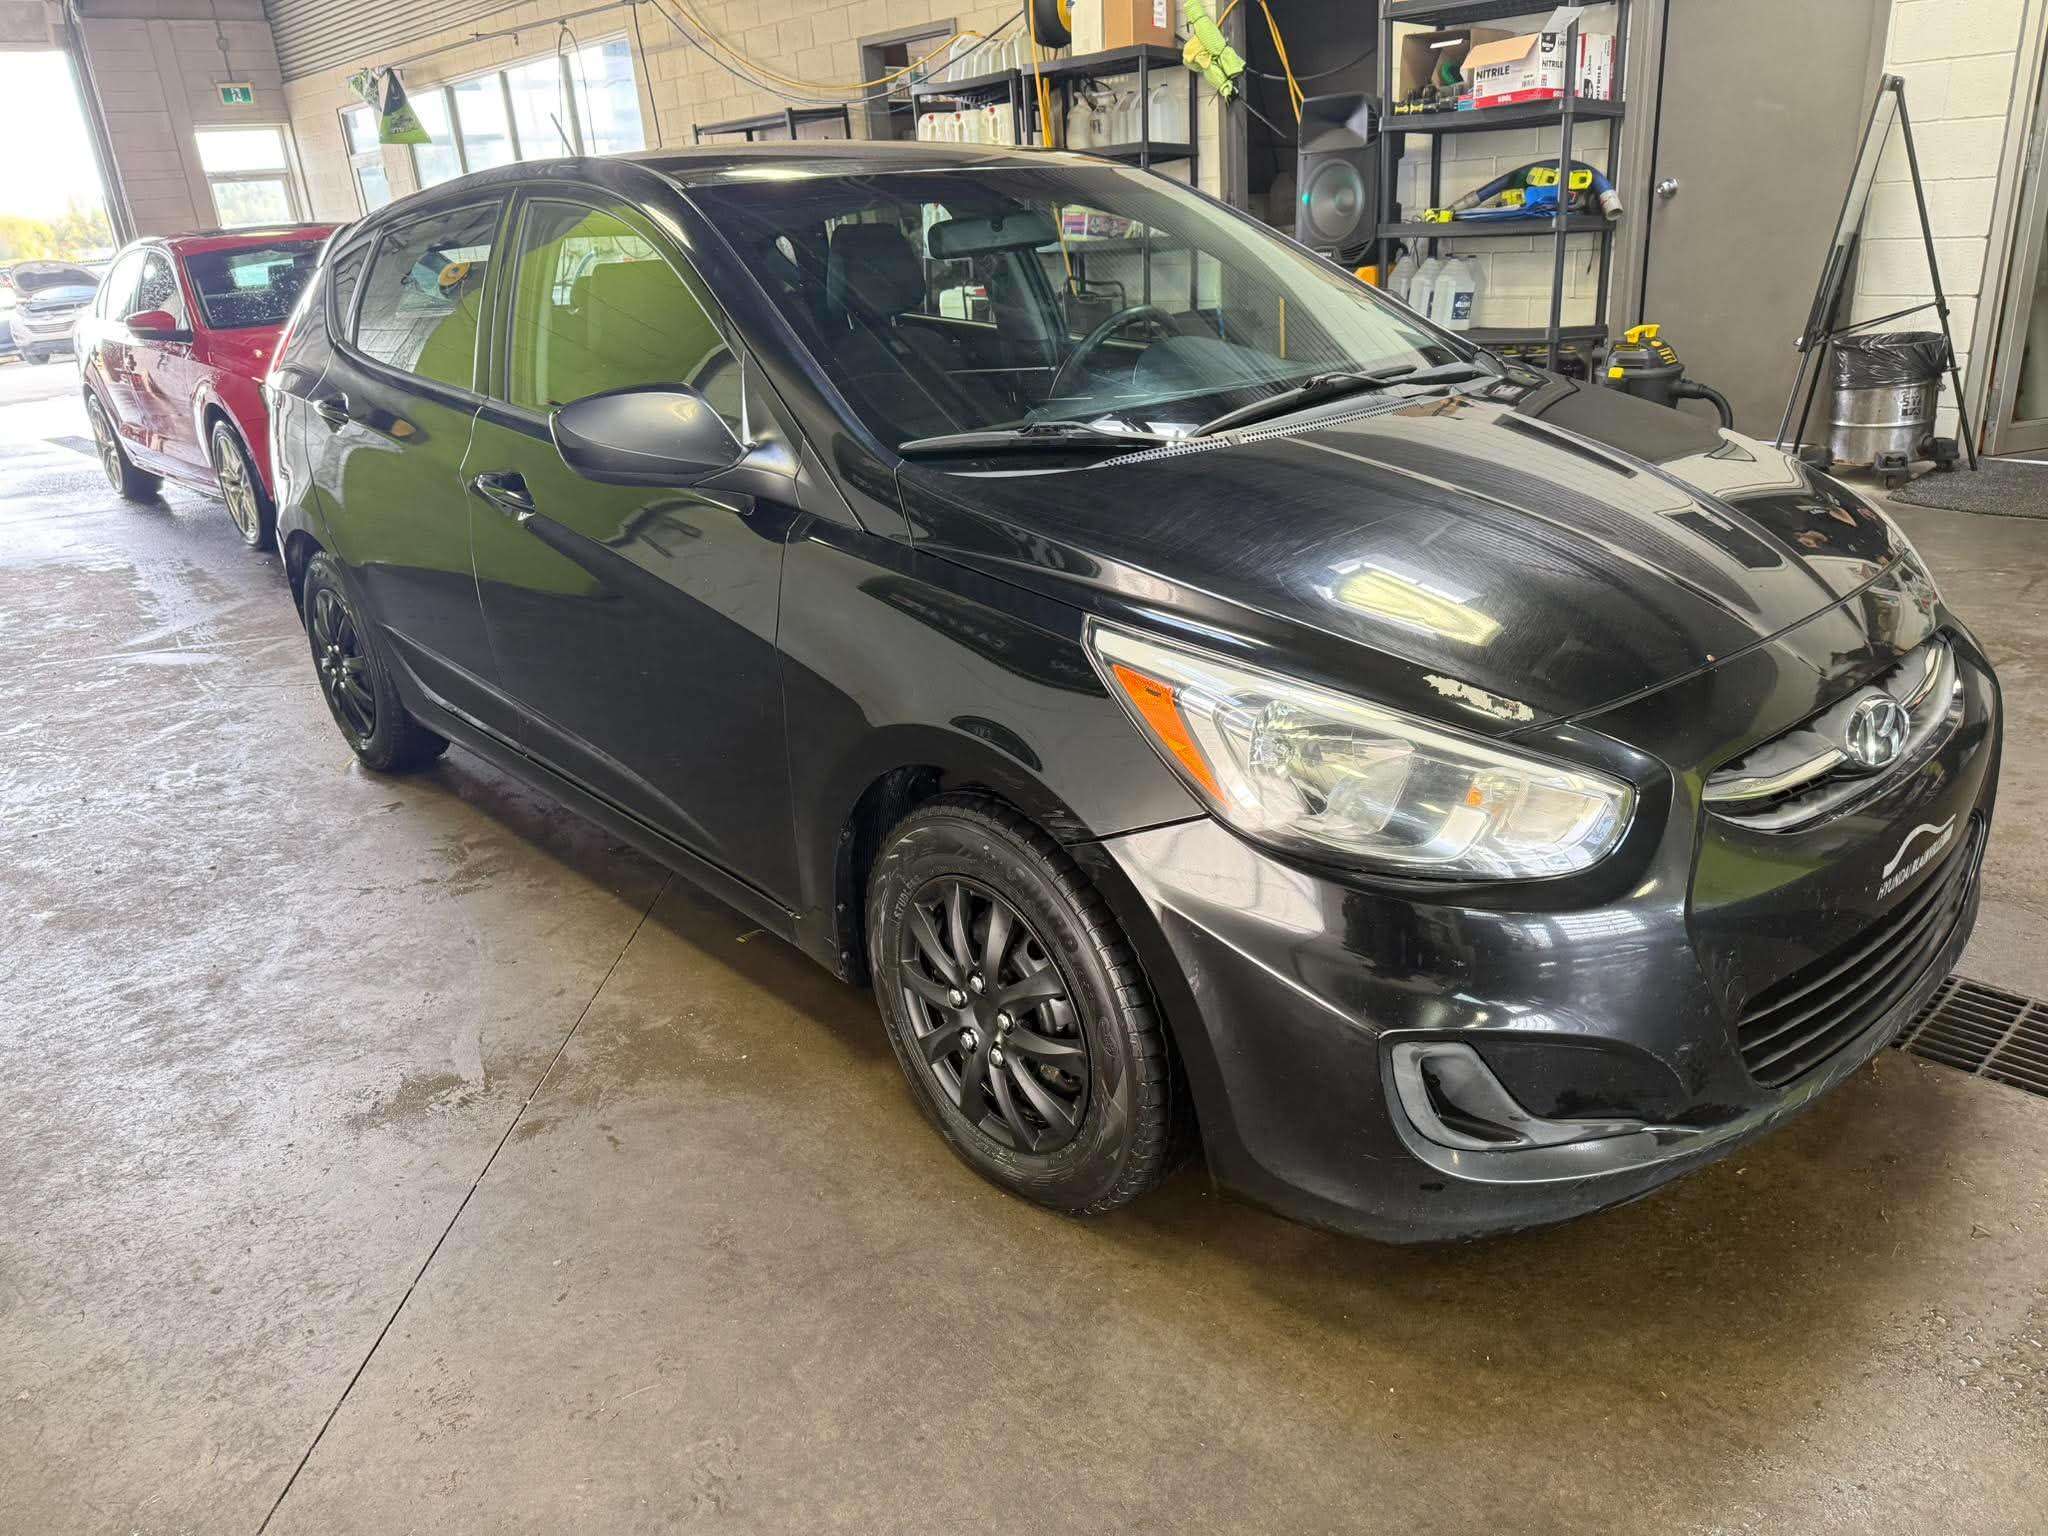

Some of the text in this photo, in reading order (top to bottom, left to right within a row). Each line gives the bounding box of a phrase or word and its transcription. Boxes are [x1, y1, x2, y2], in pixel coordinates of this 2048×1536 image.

[1476, 64, 1511, 81] NITRILE
[1541, 59, 1564, 70] NITRILE
[1877, 863, 1913, 901] HYUNDAI
